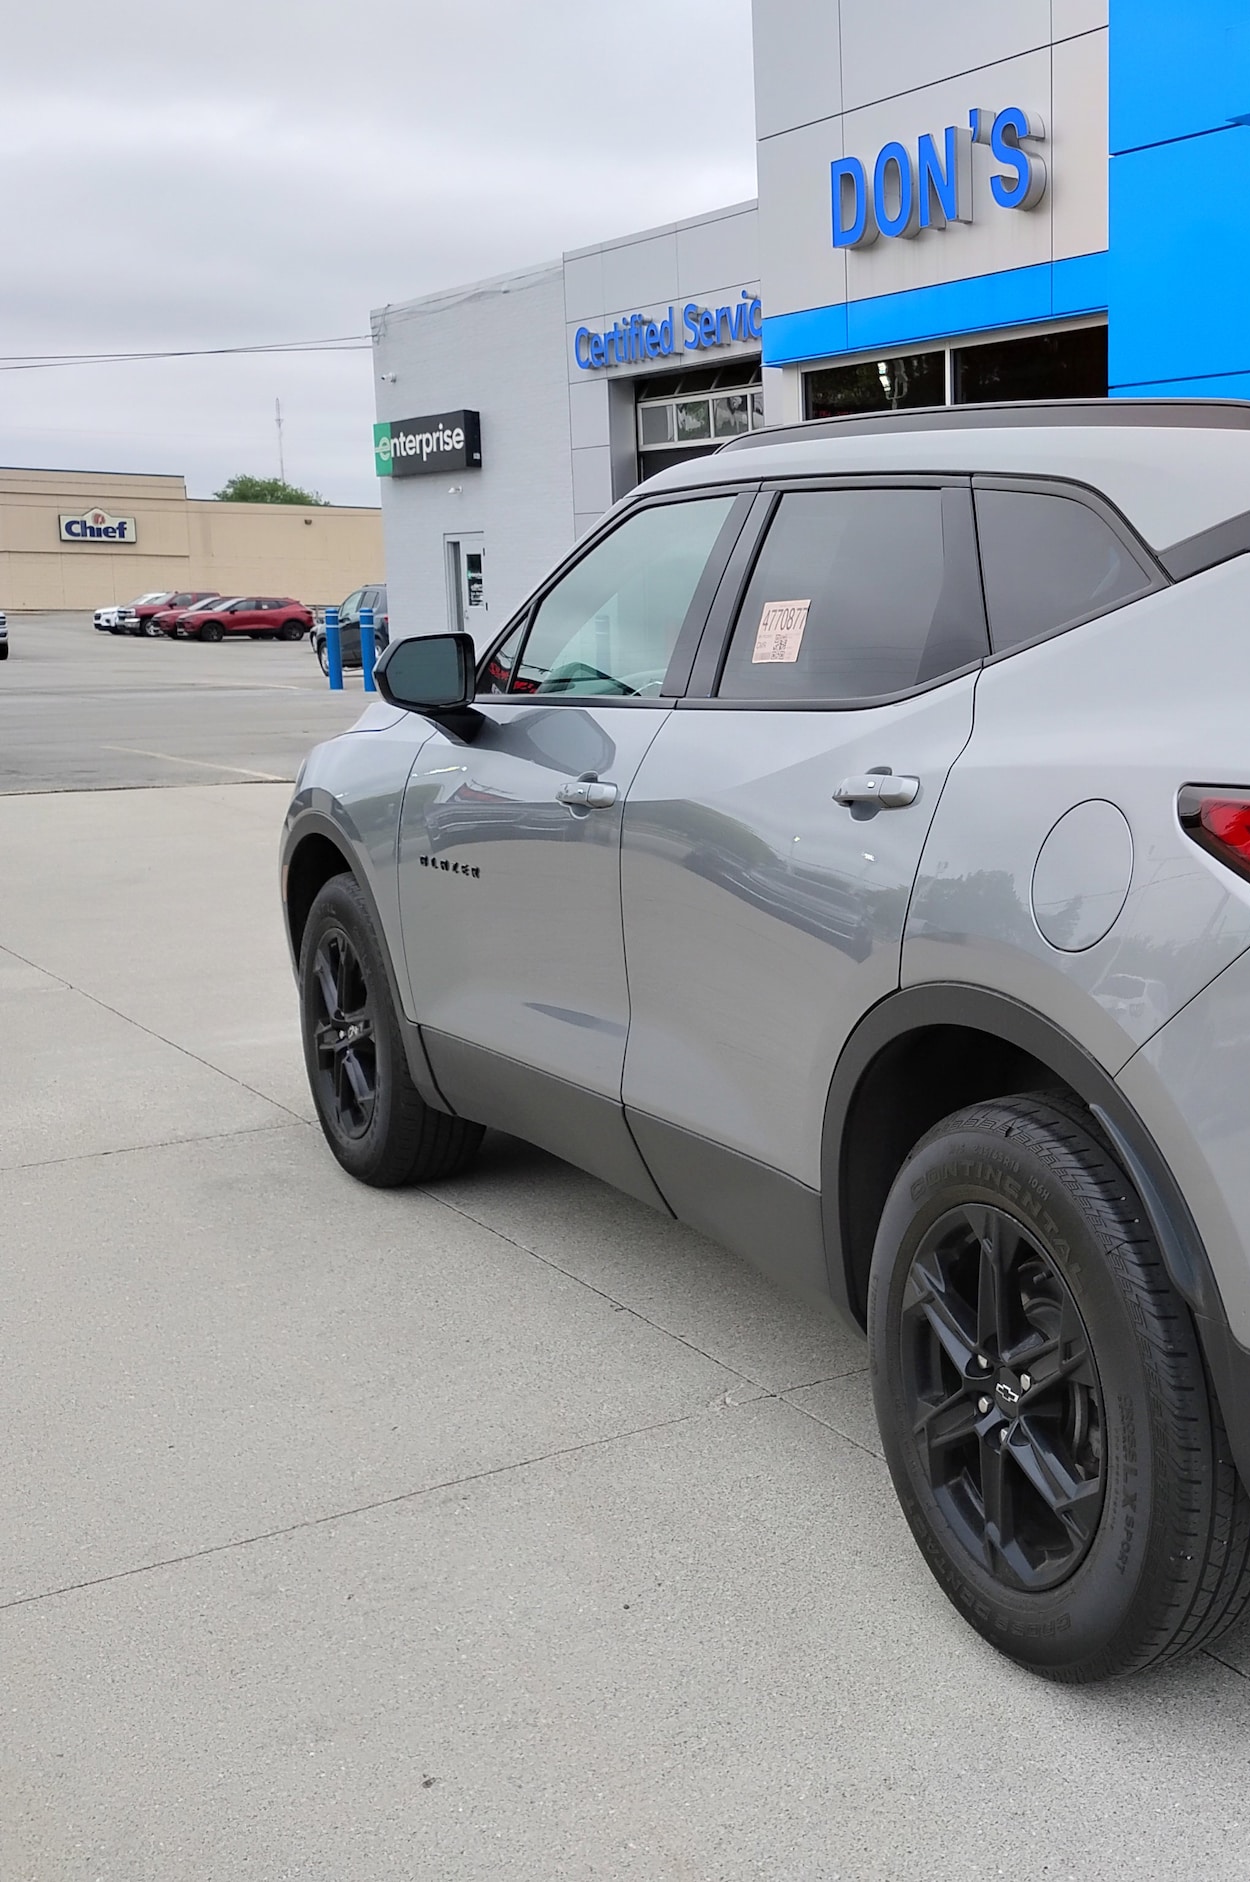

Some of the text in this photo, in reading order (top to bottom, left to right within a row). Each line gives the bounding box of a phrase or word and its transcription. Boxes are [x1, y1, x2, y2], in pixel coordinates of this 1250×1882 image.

[831, 107, 1036, 249] DON'S
[575, 306, 674, 370] Certified
[376, 423, 464, 461] enterprise
[65, 520, 127, 538] Chief
[762, 607, 809, 631] 4770877
